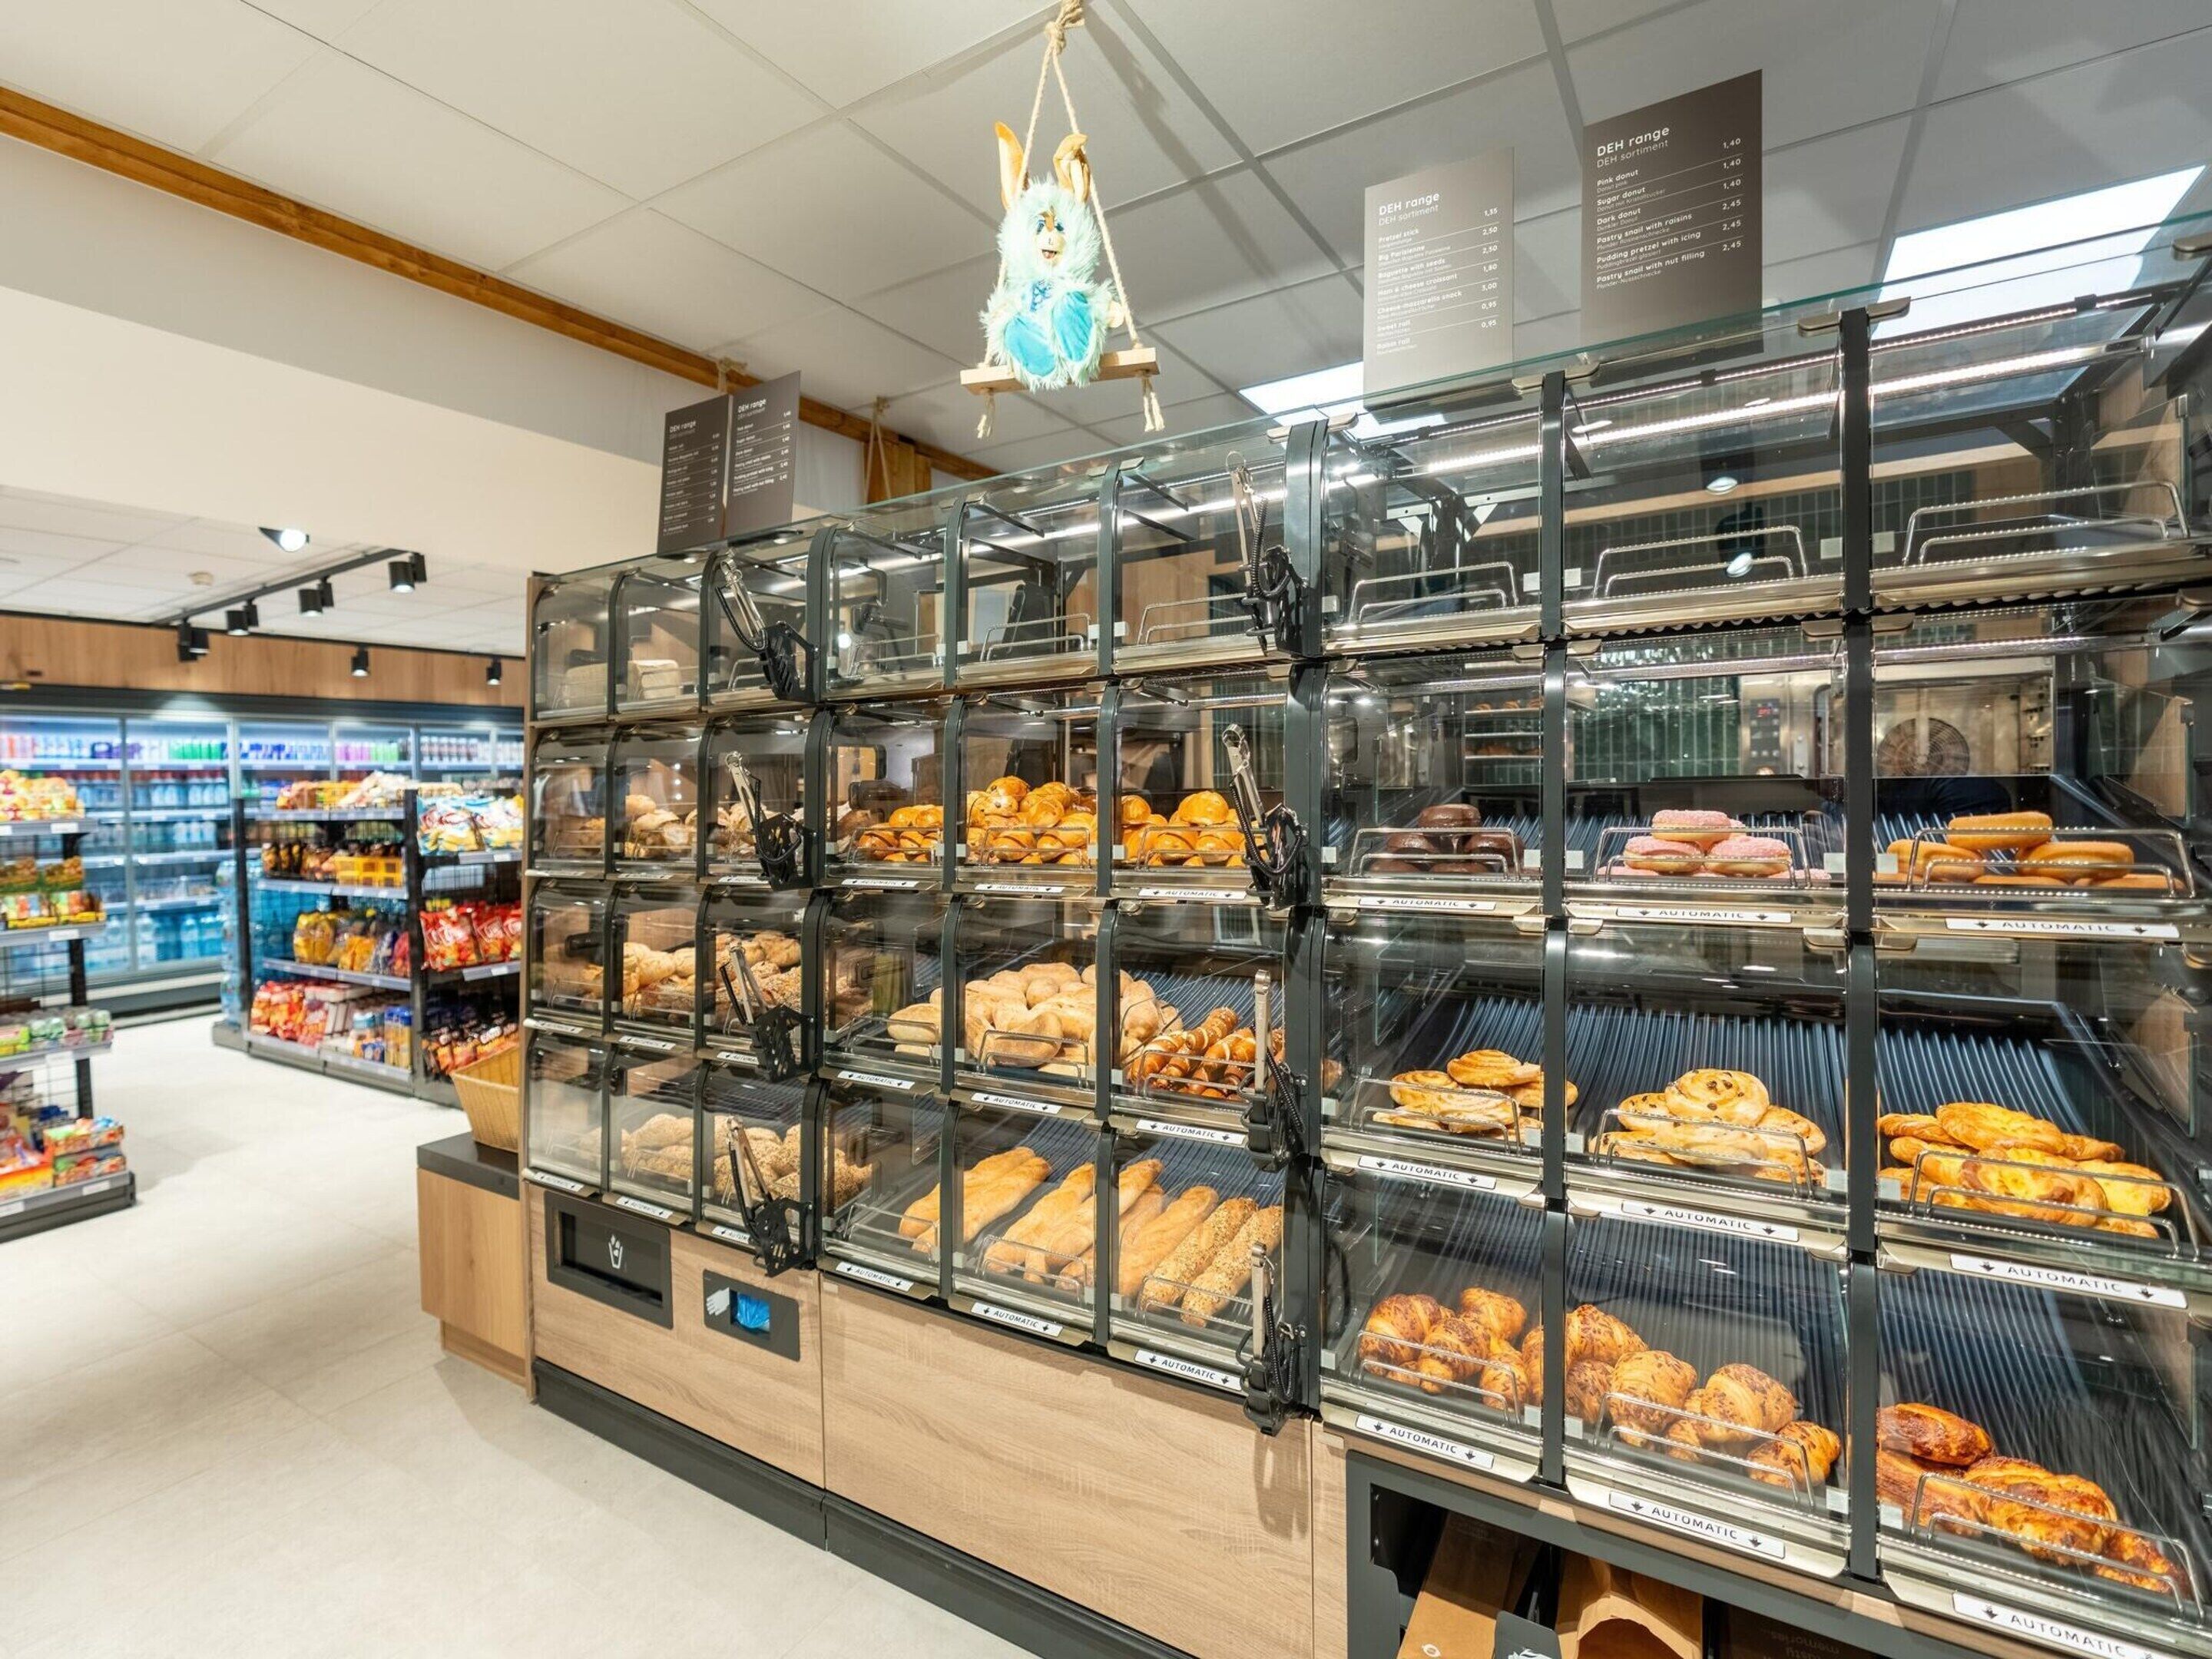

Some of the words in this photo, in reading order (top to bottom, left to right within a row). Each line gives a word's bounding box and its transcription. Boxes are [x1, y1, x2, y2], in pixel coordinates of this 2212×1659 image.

[1598, 140, 1624, 156] DEH
[1629, 127, 1670, 147] range
[1723, 138, 1740, 149] 1,40
[1598, 155, 1618, 168] DEH
[1621, 141, 1668, 160] sortiment
[1723, 158, 1740, 169] 1,40
[1598, 177, 1613, 186] Pink
[1615, 169, 1638, 181] donut
[1723, 179, 1741, 190] 1,40
[1379, 201, 1402, 215] DEH
[1406, 194, 1439, 208] range
[1598, 195, 1620, 206] Sugar
[1622, 187, 1645, 199] donut
[1723, 200, 1741, 210] 2,45
[1379, 215, 1396, 226] DEH
[1398, 205, 1438, 222] sortiment
[1598, 215, 1615, 225] Dark
[1618, 208, 1641, 220] donut
[1598, 233, 1622, 244] Pastry
[1624, 225, 1643, 237] snail
[1645, 221, 1663, 230] with
[1665, 214, 1692, 226] raisins
[1723, 220, 1741, 230] 2,45
[1598, 252, 1628, 263] Pudding
[1631, 242, 1659, 255] pretzel
[1661, 237, 1679, 247] with
[1681, 232, 1701, 242] icing
[1723, 240, 1741, 251] 2,45
[1598, 273, 1622, 283] Pastry
[1624, 266, 1643, 276] snail
[1645, 262, 1663, 270] with
[1665, 257, 1678, 266] nut
[1681, 250, 1705, 262] filling
[1392, 899, 1459, 909] AUTOMATIC
[1658, 908, 1744, 919] AUTOMATIC
[2001, 921, 2115, 932] AUTOMATIC
[993, 1097, 1037, 1108] AUTOMATIC
[1162, 1125, 1216, 1137] AUTOMATIC
[1392, 1163, 1459, 1180] AUTOMATIC
[1664, 1209, 1750, 1230] AUTOMATIC
[855, 1269, 891, 1283] AUTOMATIC
[2007, 1266, 2122, 1290] AUTOMATIC
[994, 1310, 1038, 1328] AUTOMATIC
[1161, 1359, 1216, 1379] AUTOMATIC
[1389, 1426, 1458, 1454] AUTOMATIC
[1651, 1506, 1737, 1539] AUTOMATIC
[2011, 1614, 2126, 1657] AUTOMATIC
